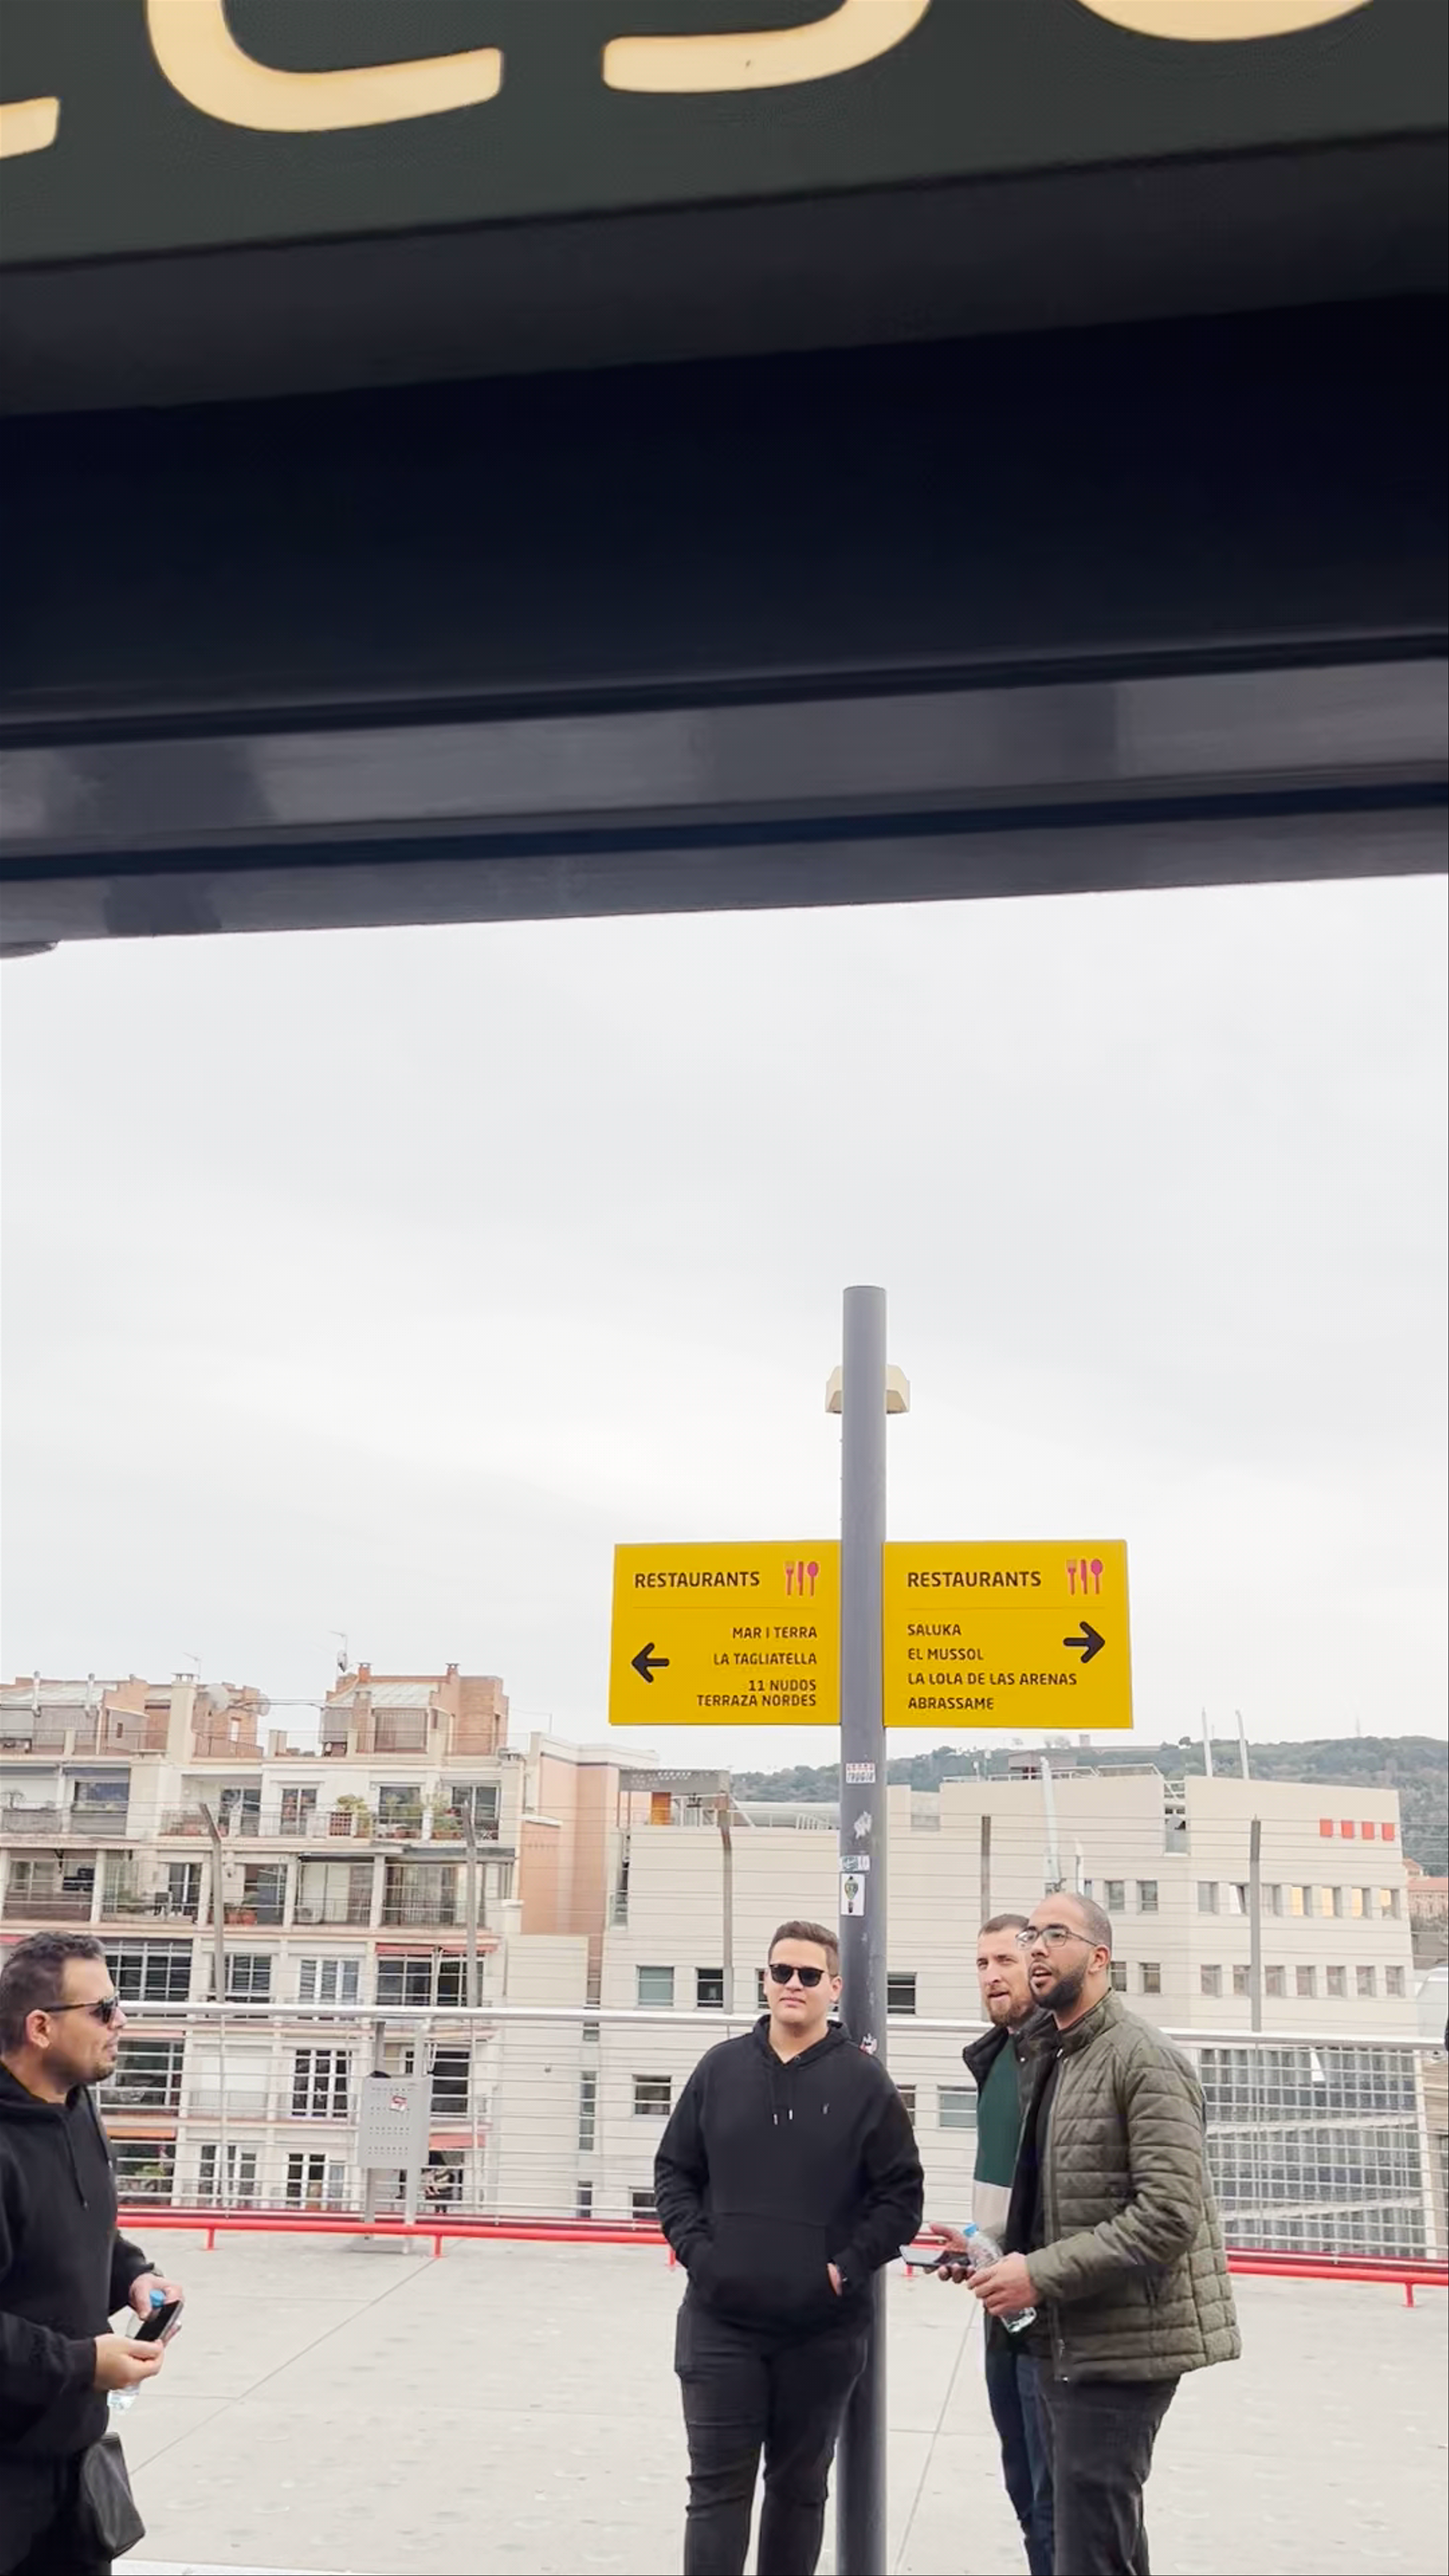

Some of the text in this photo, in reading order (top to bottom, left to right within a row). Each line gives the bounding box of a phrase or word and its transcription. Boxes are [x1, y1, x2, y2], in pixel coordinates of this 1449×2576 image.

[635, 1571, 760, 1589] RESTAURANTS
[908, 1571, 1041, 1587] RESTAURANTS
[733, 1626, 817, 1639] MAR I TERRA
[908, 1624, 961, 1636] SALUKA
[714, 1652, 817, 1665] LA TAGLIATELLA
[908, 1648, 983, 1660] EL MUSSOL
[908, 1672, 1077, 1685] LA LOLA DE LAS ARENAS
[749, 1679, 816, 1692] 11 NUDOS
[697, 1694, 816, 1707] TERRAZA NORDES
[908, 1697, 994, 1710] ABRASSAME
